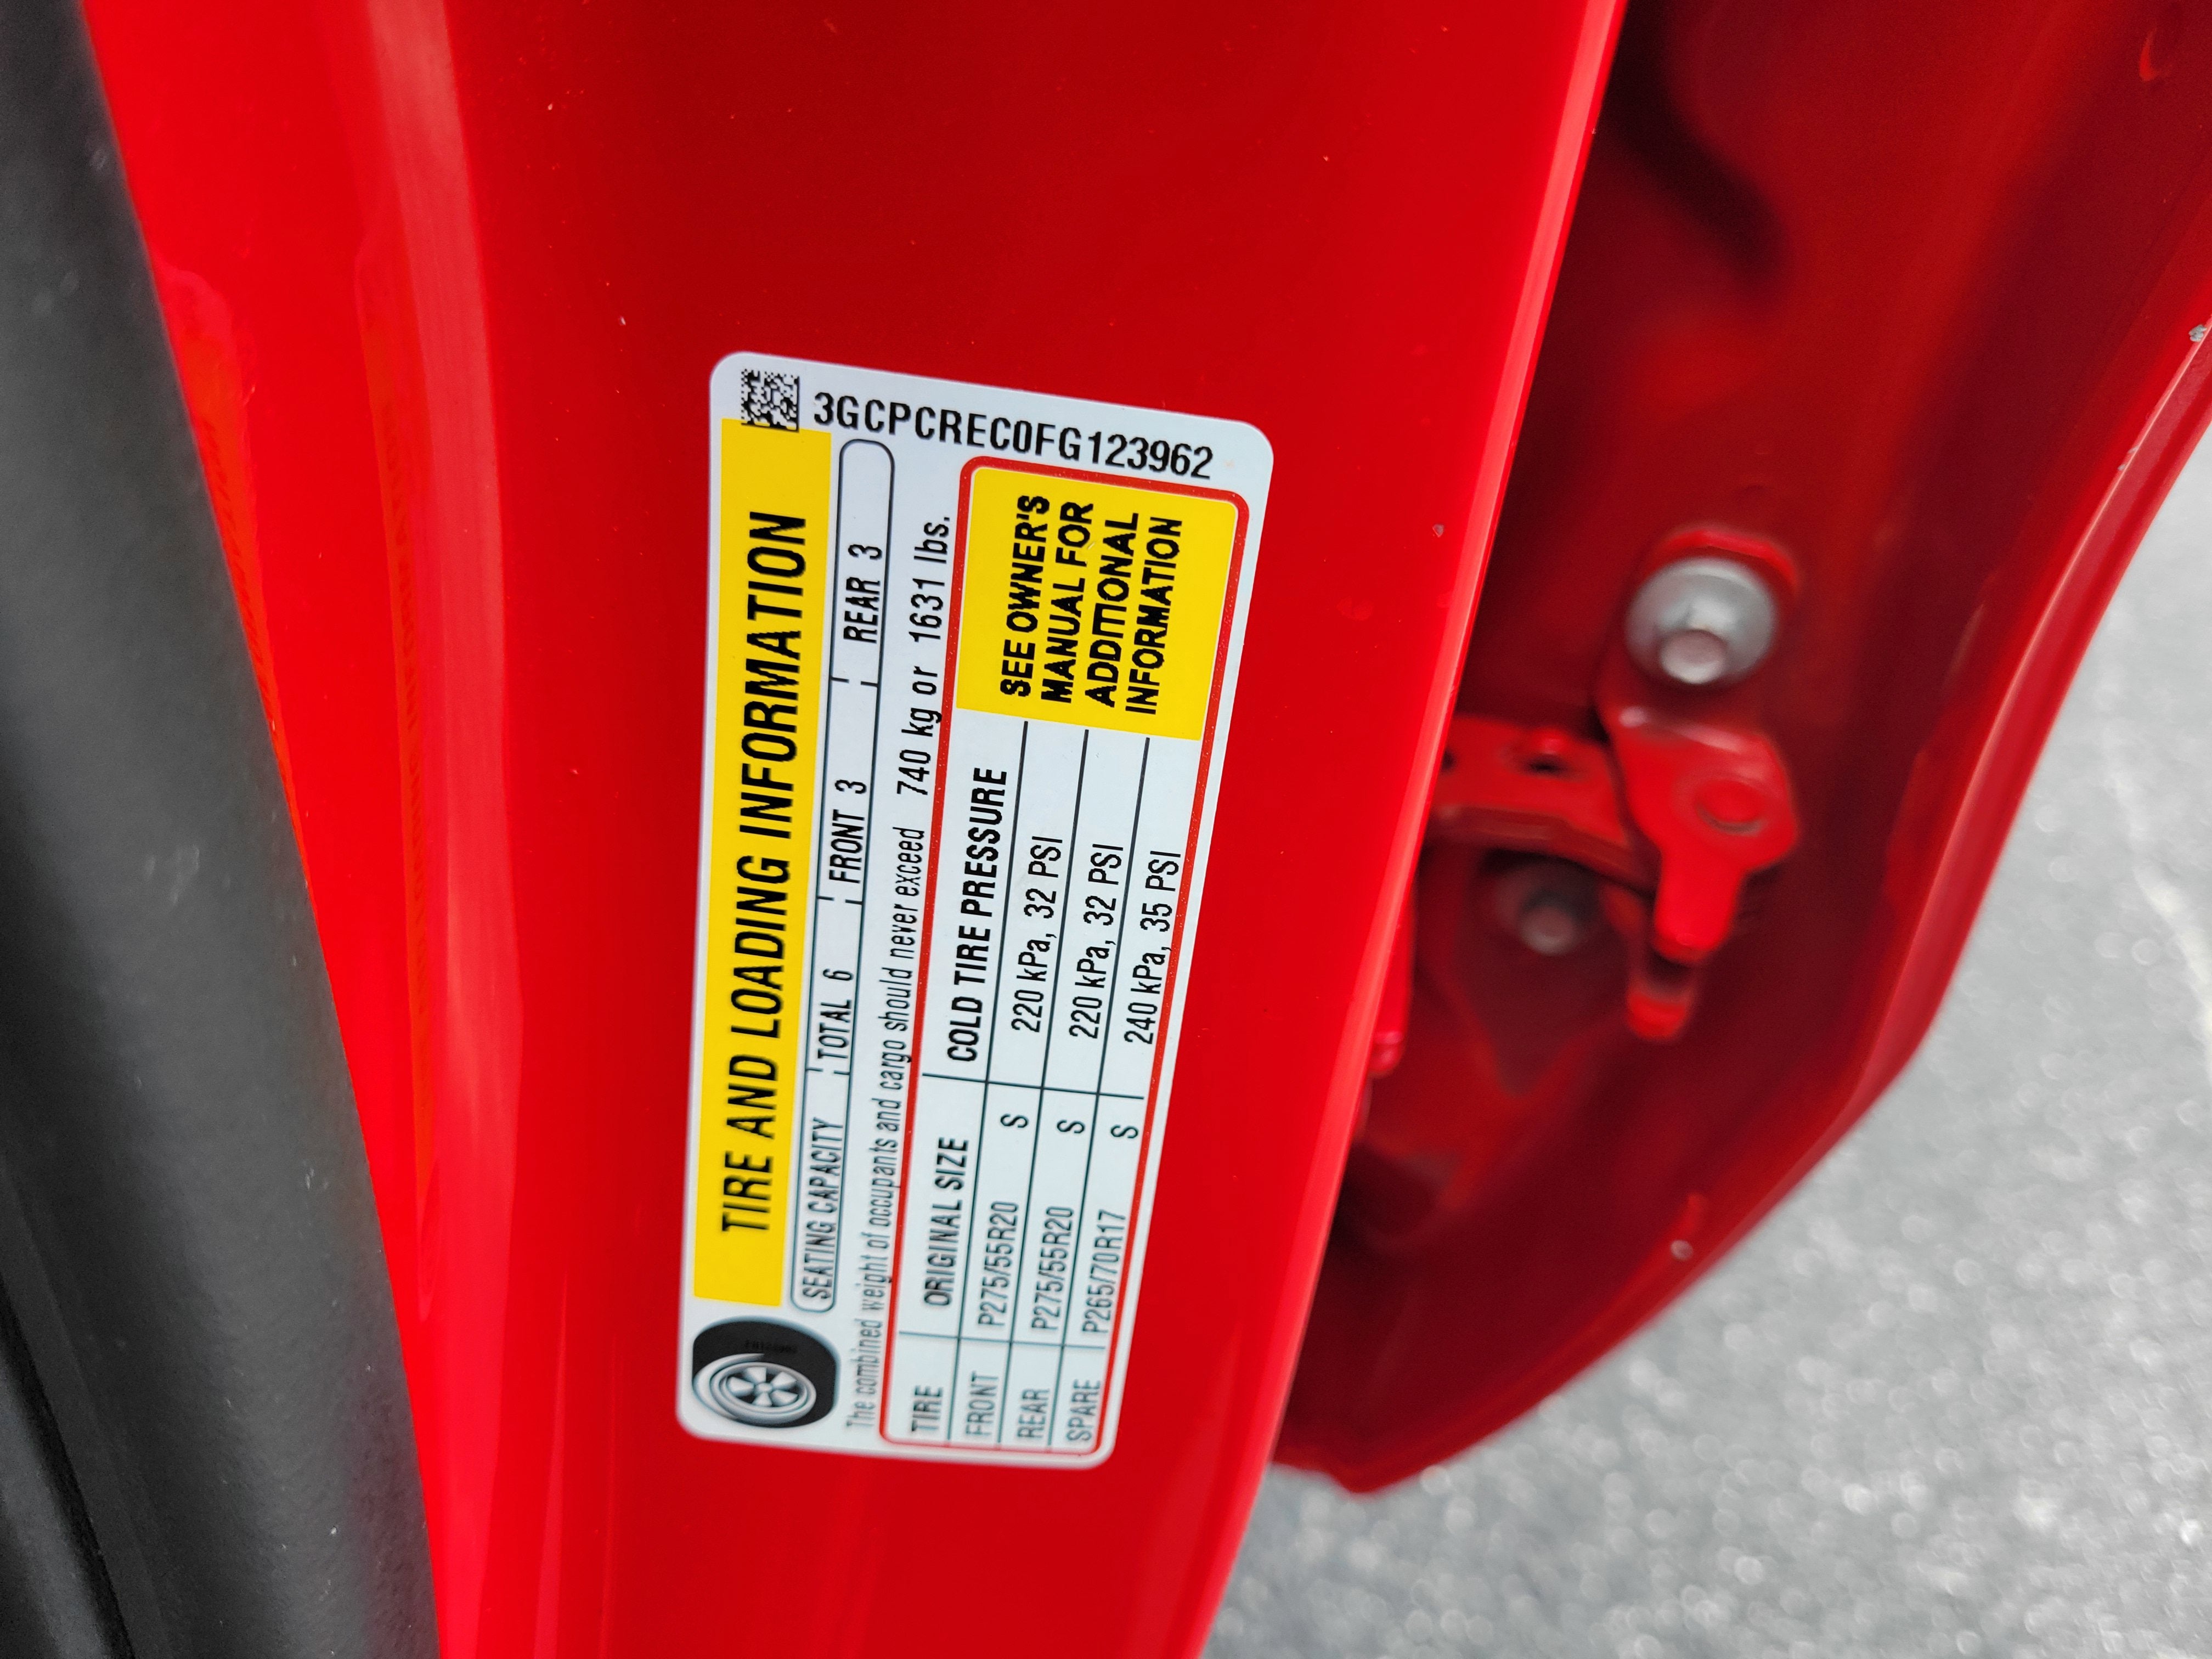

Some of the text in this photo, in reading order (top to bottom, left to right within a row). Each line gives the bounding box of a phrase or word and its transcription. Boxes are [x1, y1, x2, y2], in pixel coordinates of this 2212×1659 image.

[814, 391, 1214, 480] 3GCPCREC0FG123962
[843, 543, 883, 645] REAR 3
[999, 495, 1051, 698] SEE OWNER'S
[1040, 501, 1094, 704] MANUAL FOR
[1084, 512, 1139, 708] ADDITIONAL
[1125, 516, 1183, 715] INFORMATION
[721, 511, 806, 1232] TIRE AND LOADING INFORMATION
[828, 778, 867, 884] FRONT 3
[946, 767, 1008, 1063] COLD TIRE PRESSURE
[816, 968, 854, 1059] TOTAL 6
[845, 516, 950, 1429] The combined weight of occupants and cargo should never exceed 740 kg or 1631 lbs.
[1010, 836, 1063, 1033] 220 kPa, 32 PSI
[1068, 843, 1124, 1040] 220 kPa, 32 PSI
[1123, 850, 1182, 1045] 240 kPa, 35 PSI
[802, 1117, 844, 1300] SEATING CAPACITY
[923, 1137, 969, 1307] ORIGINAL SIZE
[977, 1113, 1029, 1327] P275/55R20 S
[1030, 1119, 1086, 1330] P275/55R20 S
[1081, 1124, 1139, 1334] P265/70R17 S
[910, 1386, 943, 1432] TIRE
[964, 1372, 998, 1436] FRONT
[1015, 1389, 1049, 1440] REAR
[1065, 1380, 1101, 1442] SPARE
